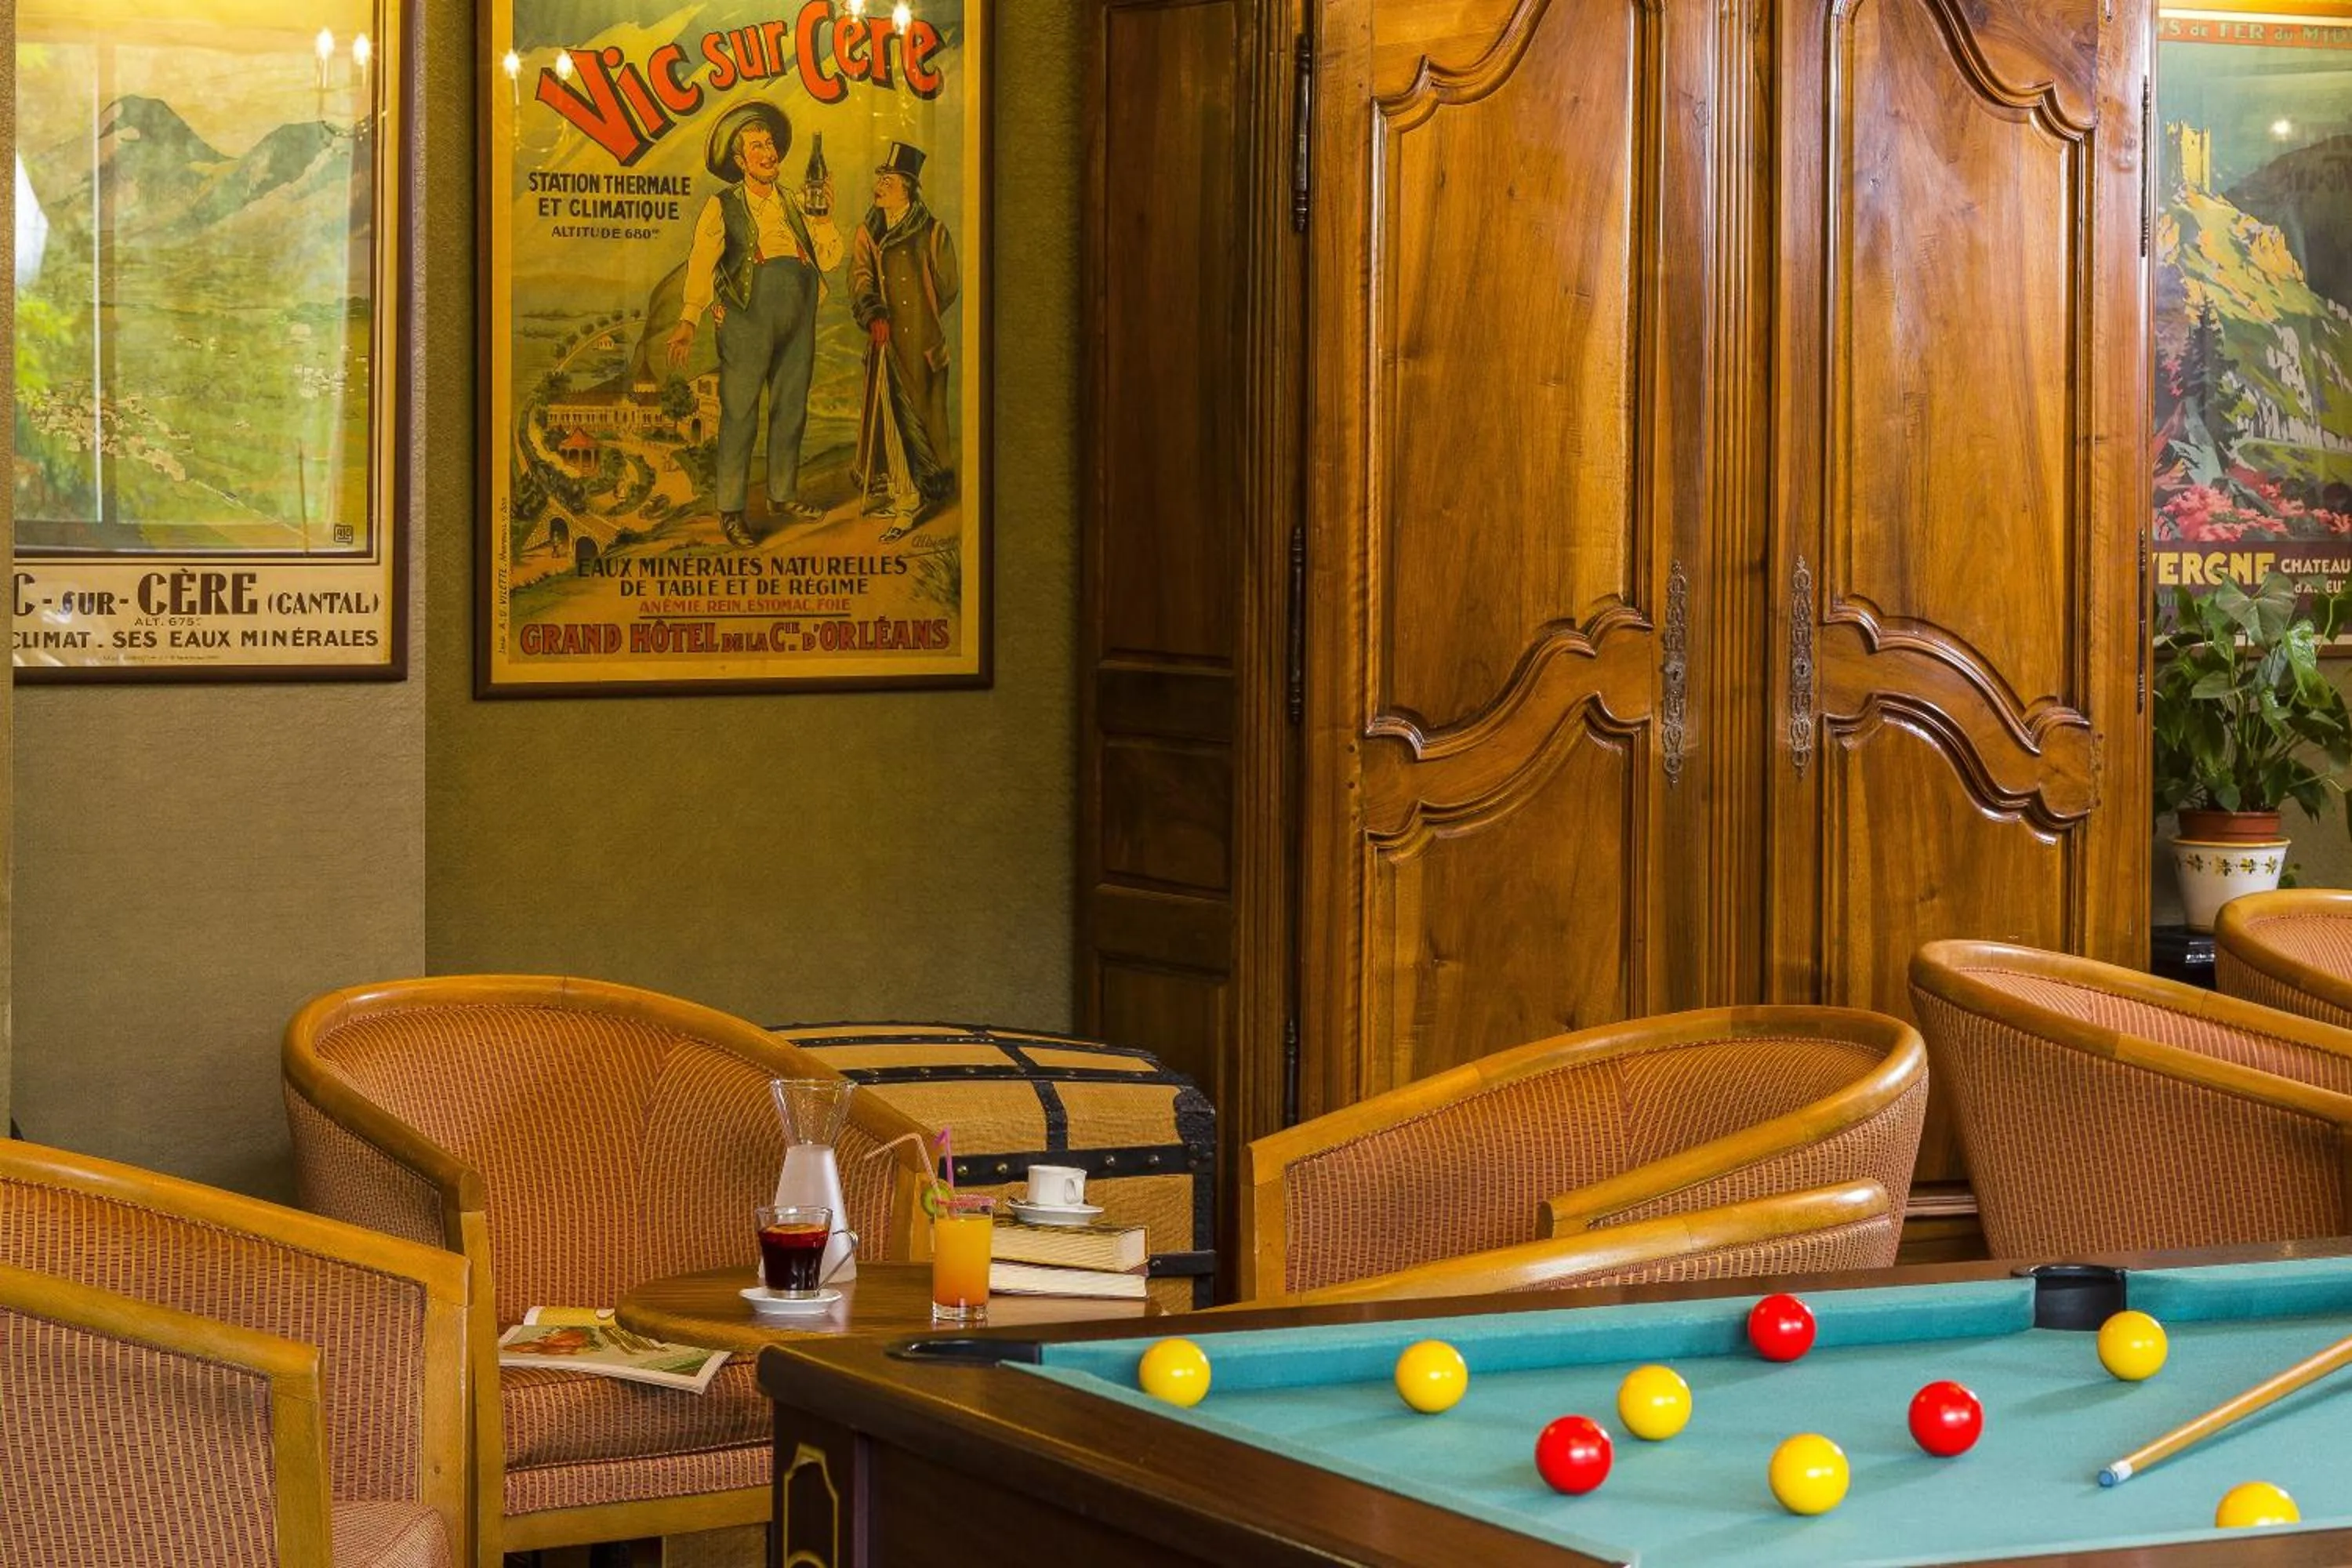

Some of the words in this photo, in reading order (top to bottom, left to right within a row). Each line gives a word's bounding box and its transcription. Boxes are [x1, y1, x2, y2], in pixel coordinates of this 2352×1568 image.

[2218, 23, 2266, 40] FER
[702, 20, 789, 91] sur
[528, 172, 600, 194] STATION
[603, 175, 691, 195] THERMALE
[538, 198, 562, 217] ET
[569, 198, 680, 221] CLIMATIQUE
[551, 226, 622, 239] ALTITUDE
[577, 557, 633, 578] EAUX
[639, 554, 763, 578] MINÉRALES
[771, 556, 908, 576] NATURELLES
[2152, 551, 2276, 586] ERGNE
[2280, 557, 2351, 574] CHATEAU
[619, 579, 647, 597] DE
[655, 579, 719, 597] TABLE
[726, 579, 748, 595] ET
[757, 579, 780, 595] DE
[789, 576, 869, 595] RÉGIME
[267, 591, 380, 616] (CANTAL)
[817, 598, 851, 612] FOIE
[134, 616, 164, 626] ALT.
[112, 630, 158, 649] SES
[169, 630, 231, 649] EAUX
[240, 626, 379, 648] MINÉRALES
[520, 623, 622, 656] GRAND
[630, 618, 720, 653] HÔTEL
